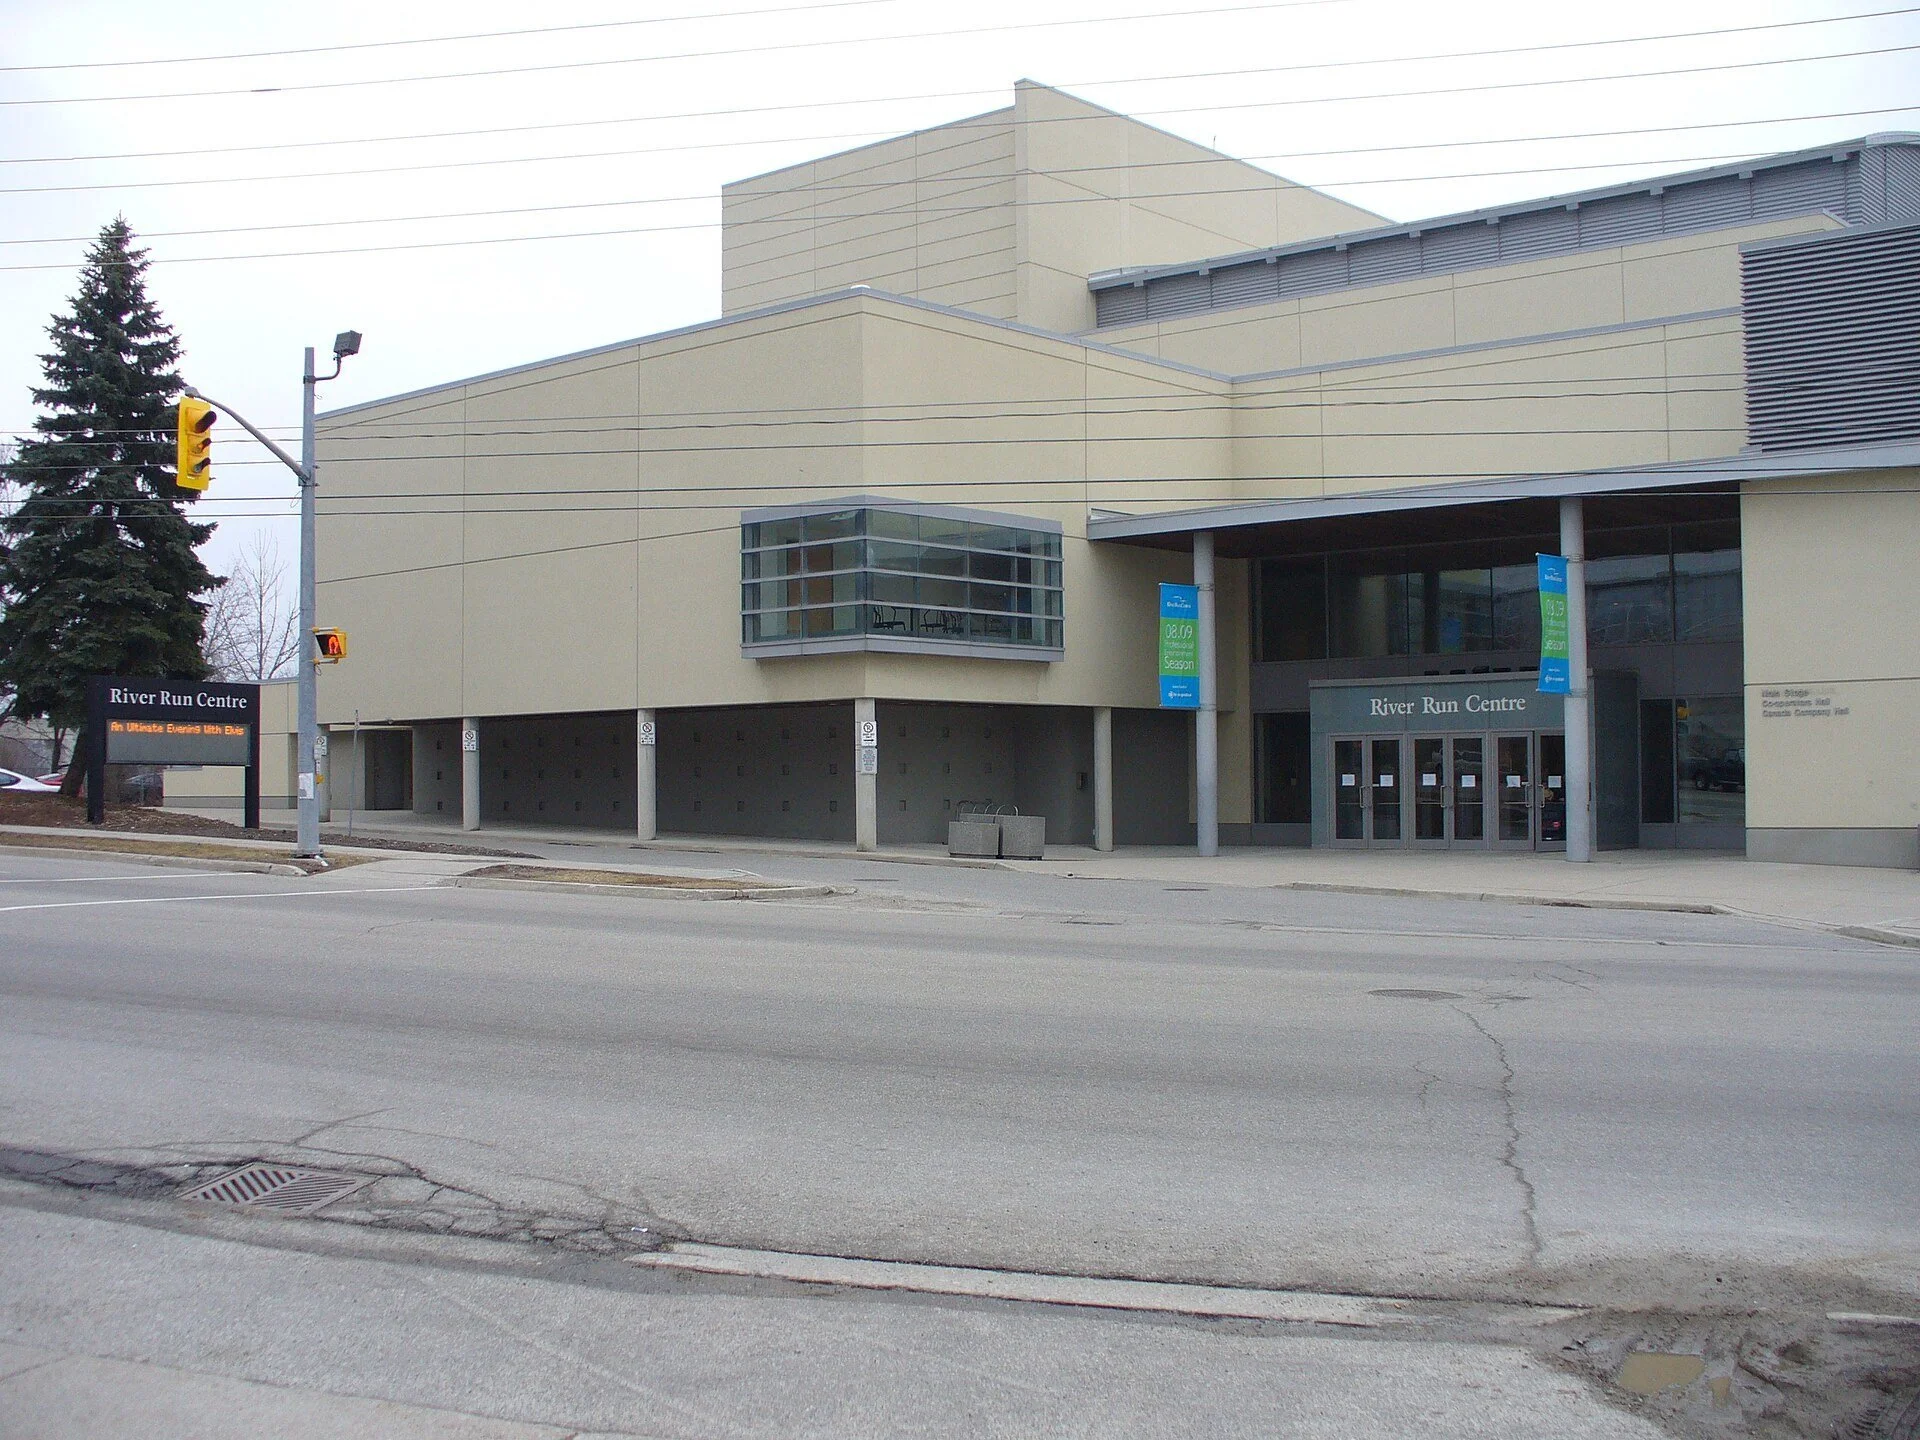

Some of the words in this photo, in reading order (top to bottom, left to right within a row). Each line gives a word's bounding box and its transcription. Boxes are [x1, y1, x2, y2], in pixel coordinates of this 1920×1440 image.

[1165, 623, 1193, 639] 08.09
[1164, 655, 1195, 670] Season
[109, 687, 156, 705] River
[160, 690, 193, 707] Run
[196, 692, 247, 709] Centre
[1370, 697, 1415, 716] River
[1421, 696, 1459, 715] Run
[1465, 694, 1526, 713] Centre
[110, 721, 124, 732] An
[127, 722, 163, 733] Ultimate
[166, 723, 201, 734] Evening
[203, 724, 222, 735] With
[224, 725, 245, 736] Elvis
